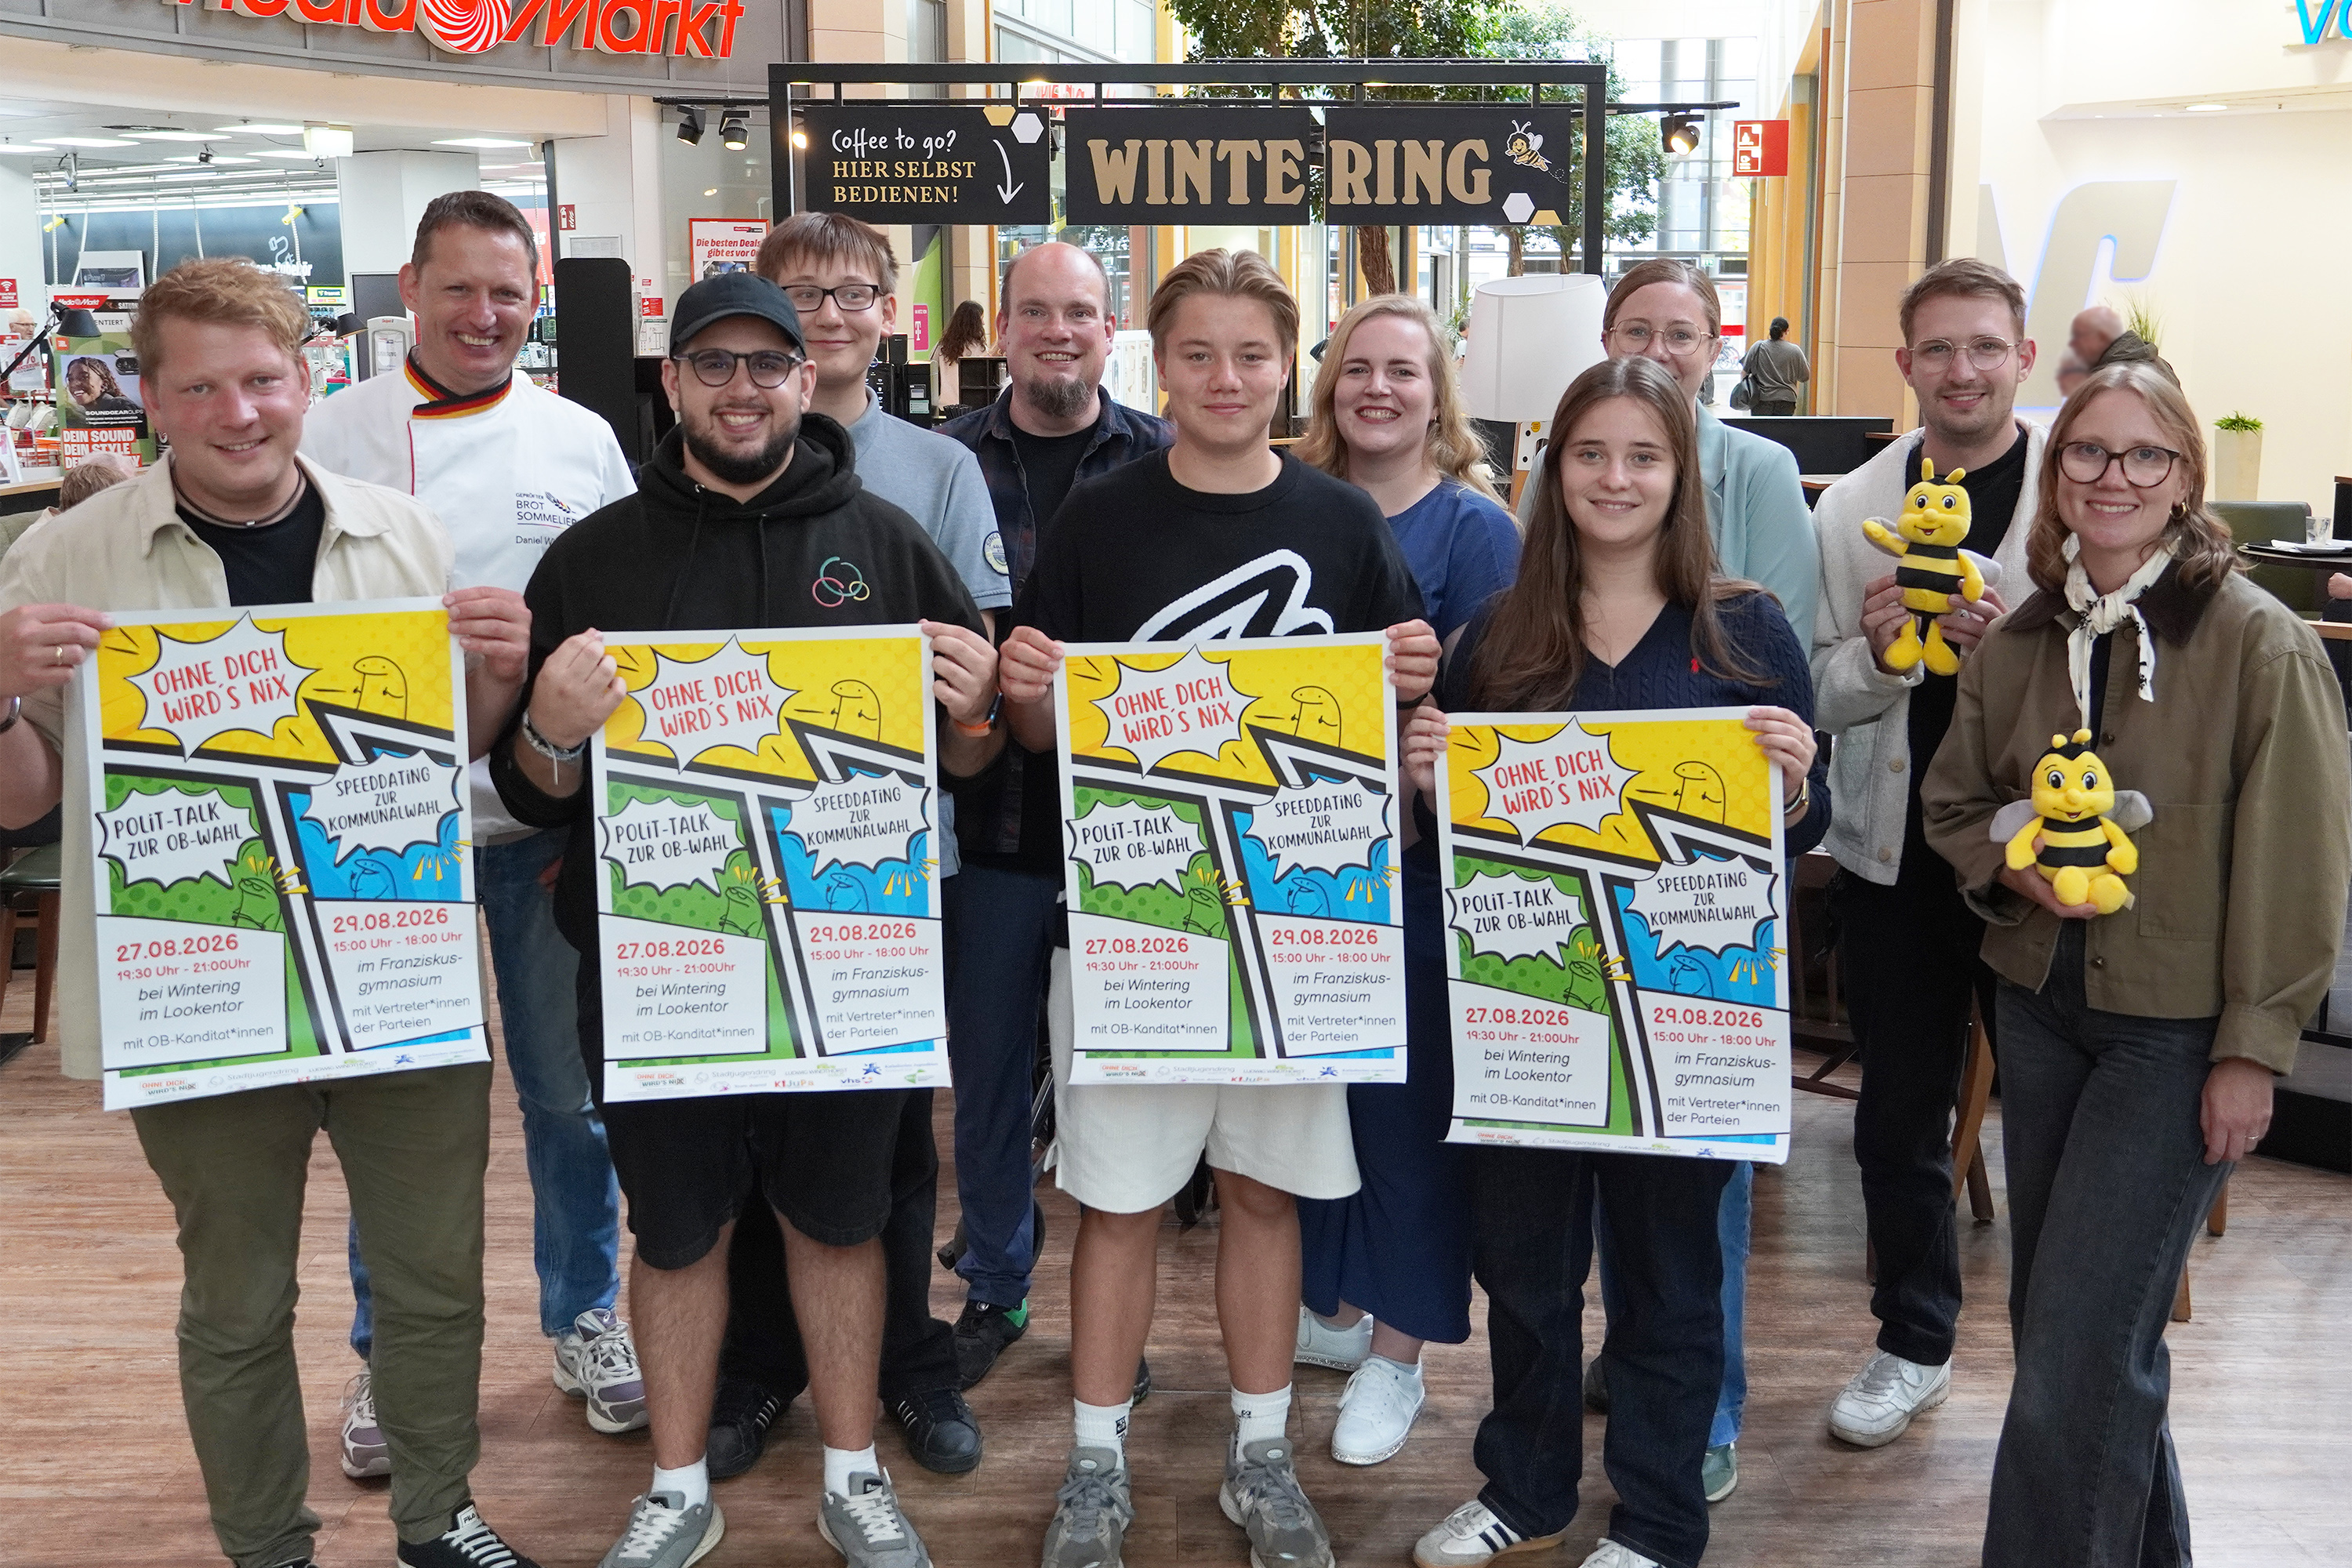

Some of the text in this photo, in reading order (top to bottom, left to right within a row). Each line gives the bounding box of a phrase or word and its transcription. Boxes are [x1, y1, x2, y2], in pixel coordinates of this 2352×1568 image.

[832, 128, 957, 158] Coffee to go?
[833, 162, 977, 180] HIER SELBST
[833, 185, 959, 204] BEDIENEN!
[707, 249, 724, 258] gibt
[63, 430, 135, 442] DEIN SOUND
[64, 444, 89, 456] DEIN
[517, 500, 545, 510] BROT
[516, 535, 543, 544] Daniel
[154, 648, 278, 695] OHNE DICH
[652, 670, 761, 710] OHNE DICH
[1115, 677, 1222, 717] OHNE DICH
[1494, 750, 1603, 789] OHNE DICH
[375, 791, 397, 807] ZUR
[328, 797, 441, 831] KOMMUNALWAHL
[850, 809, 869, 823] ZUR
[1311, 815, 1331, 829] ZUR
[808, 817, 910, 845] KOMMUNALWAHL
[1269, 822, 1372, 849] KOMMUNALWAHL
[128, 823, 241, 859] ZUR OB-WAHL
[628, 835, 728, 863] ZUR OB-WAHL
[1094, 837, 1192, 863] ZUR OB-WAHL
[1693, 892, 1715, 906] ZUR
[333, 908, 448, 933] 29.08.2026
[1474, 909, 1573, 933] ZUR OB-WAHL
[1650, 906, 1757, 926] KOMMUNALWAHL
[811, 923, 916, 942] 29.08.2026
[1272, 929, 1377, 945] 29.08.2026
[117, 934, 238, 962] 27.08.2026
[618, 938, 724, 960] 27.08.2026
[811, 946, 929, 960] 15:00 Uhr 18:00 Uhr
[1086, 938, 1189, 954] 27.08.2026
[358, 954, 463, 972] im Franziskus-
[1087, 961, 1115, 971] 19:30
[1119, 961, 1138, 971] Uhr
[1272, 953, 1391, 963] 15:00 Uhr 18:00 Uhr
[617, 967, 648, 977] 19:30
[652, 966, 672, 975] Uhr
[832, 966, 928, 981] im Franziskus-
[1294, 972, 1390, 984] im Franziskus-
[139, 982, 240, 1000] bei Wintering
[358, 975, 441, 996] gymnasium
[636, 984, 726, 997] bei Wintering
[1104, 979, 1190, 993] bei Wintering
[833, 987, 909, 1003] gymnasium
[1105, 997, 1192, 1009] im Lookentor
[1294, 993, 1370, 1006] gymnasium
[140, 1000, 244, 1021] im Lookentor
[637, 1001, 728, 1016] im Lookentor
[1466, 1008, 1569, 1025] 27.08.2026
[1287, 1016, 1305, 1025] mit
[1654, 1007, 1762, 1028] 29.08.2026
[1091, 1025, 1107, 1033] mit
[1287, 1031, 1359, 1041] der Parteien
[1467, 1030, 1495, 1040] 19:30
[1499, 1032, 1518, 1040] Uhr
[1653, 1032, 1776, 1047] 15:00 Uhr 18:00 Uhr
[1484, 1049, 1570, 1067] bei Wintering
[1675, 1053, 1776, 1069] im Franziskus-
[712, 1069, 776, 1078] Stadtjugendring
[1485, 1068, 1573, 1083] im Lookentor
[1675, 1074, 1755, 1087] gymnasium
